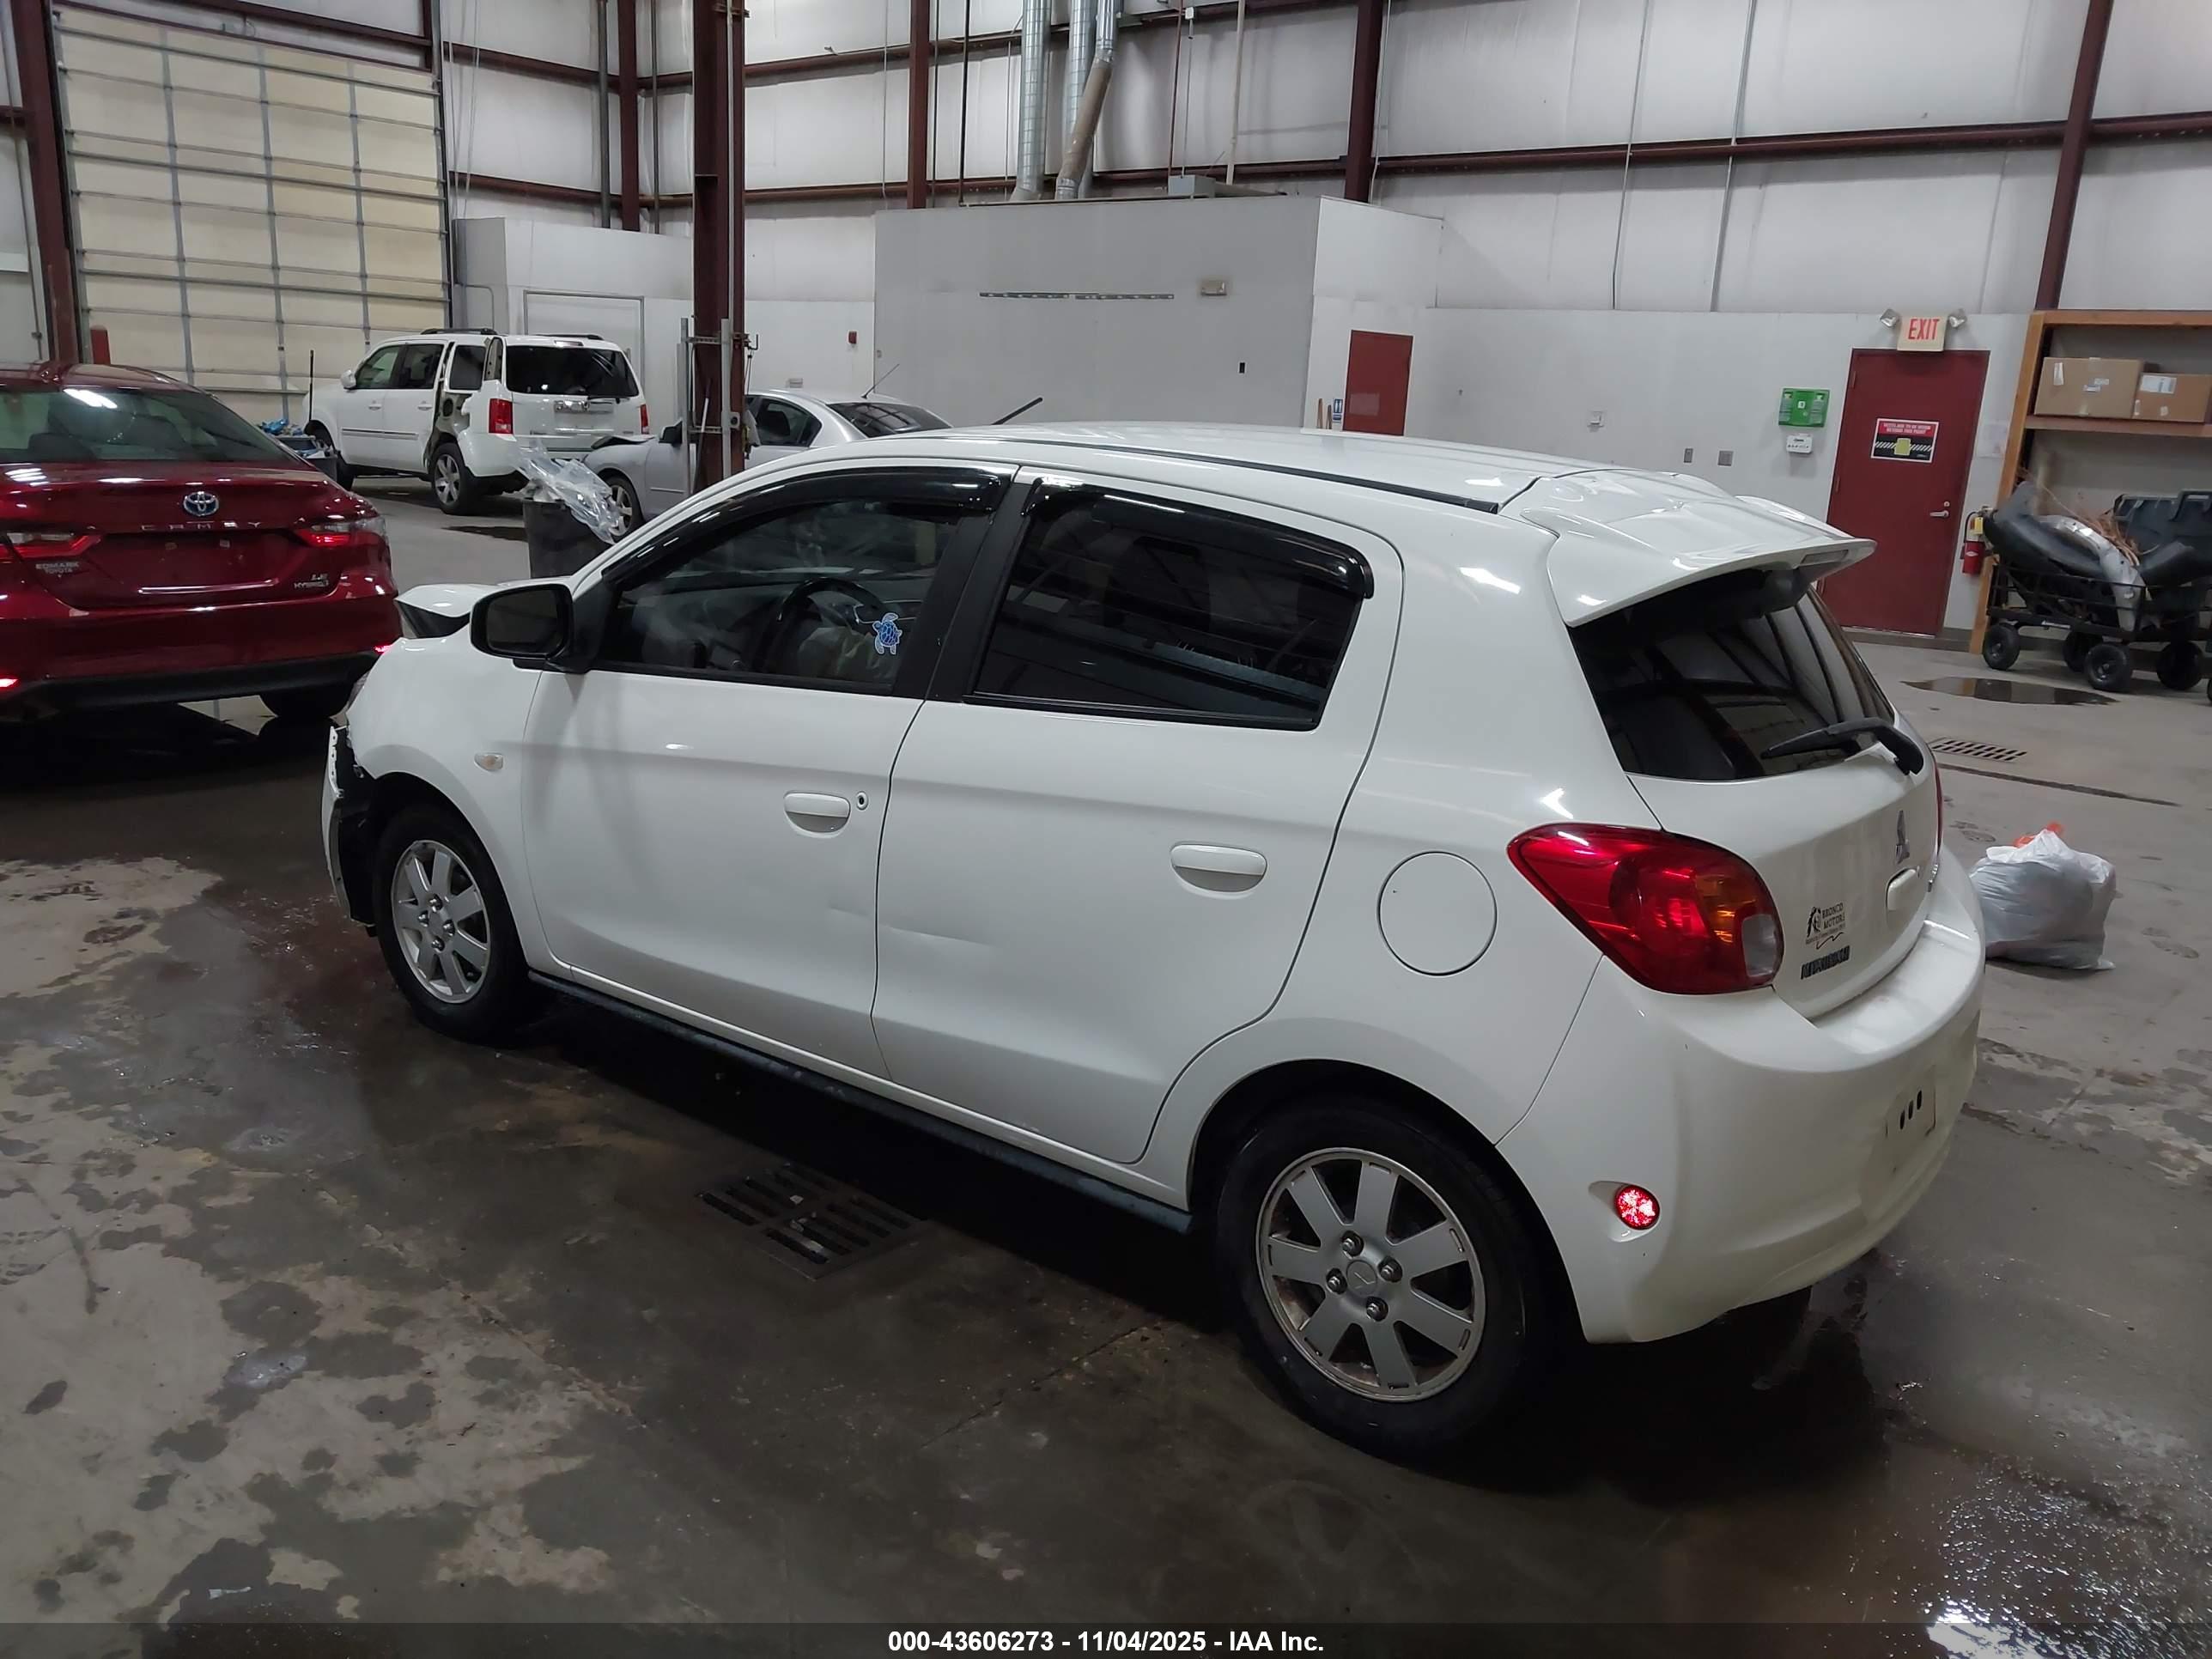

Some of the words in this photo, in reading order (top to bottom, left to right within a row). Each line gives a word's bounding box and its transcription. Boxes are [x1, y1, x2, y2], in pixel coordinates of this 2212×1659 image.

[1908, 319, 1940, 340] EXIT
[1821, 902, 1844, 919] BRONCO
[1823, 912, 1845, 930] MOTORS
